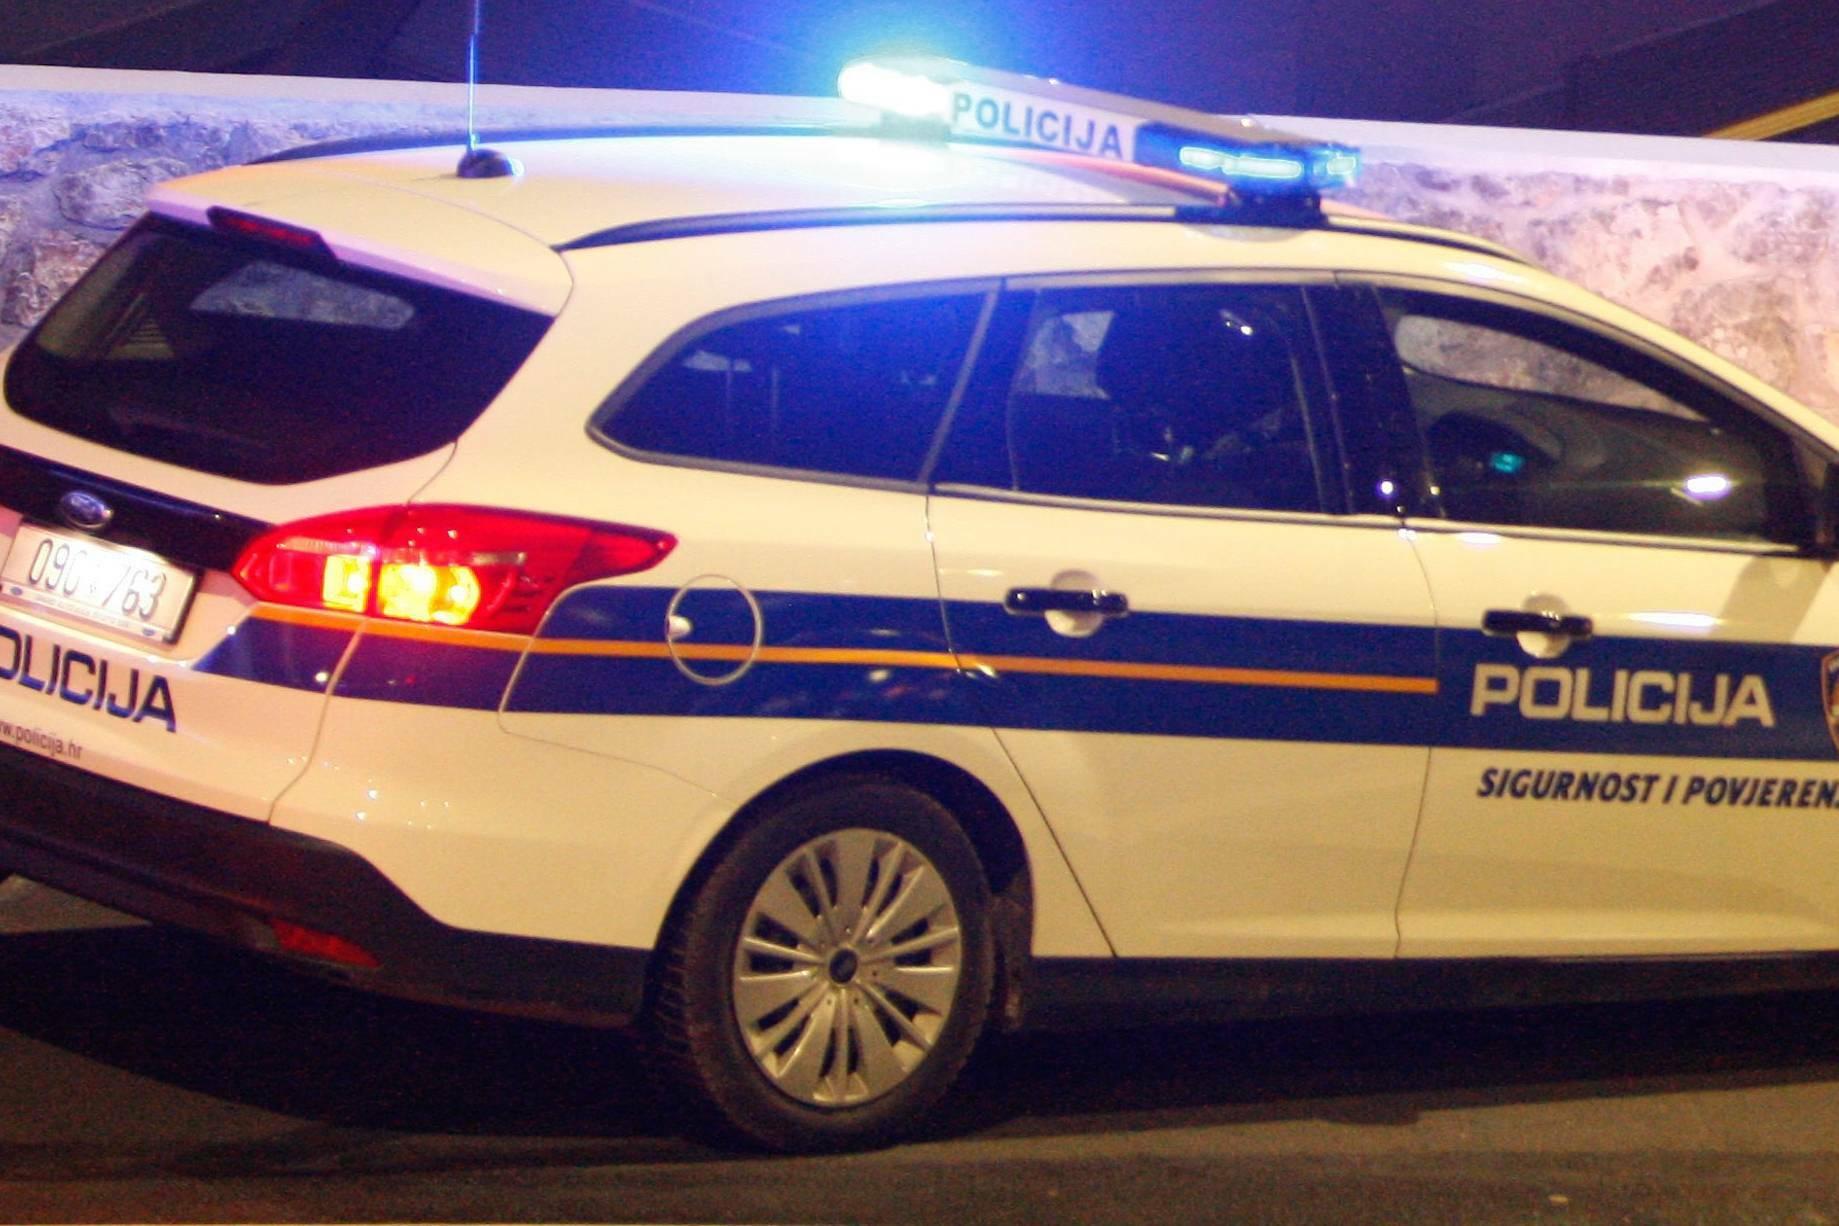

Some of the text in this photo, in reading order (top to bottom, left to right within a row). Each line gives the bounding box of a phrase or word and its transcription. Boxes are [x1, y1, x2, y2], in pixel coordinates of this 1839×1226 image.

[952, 92, 1123, 159] POLICIJA
[1470, 663, 1776, 728] POLICIJA
[1477, 767, 1839, 809] SIGURNOST I POVJEREN
